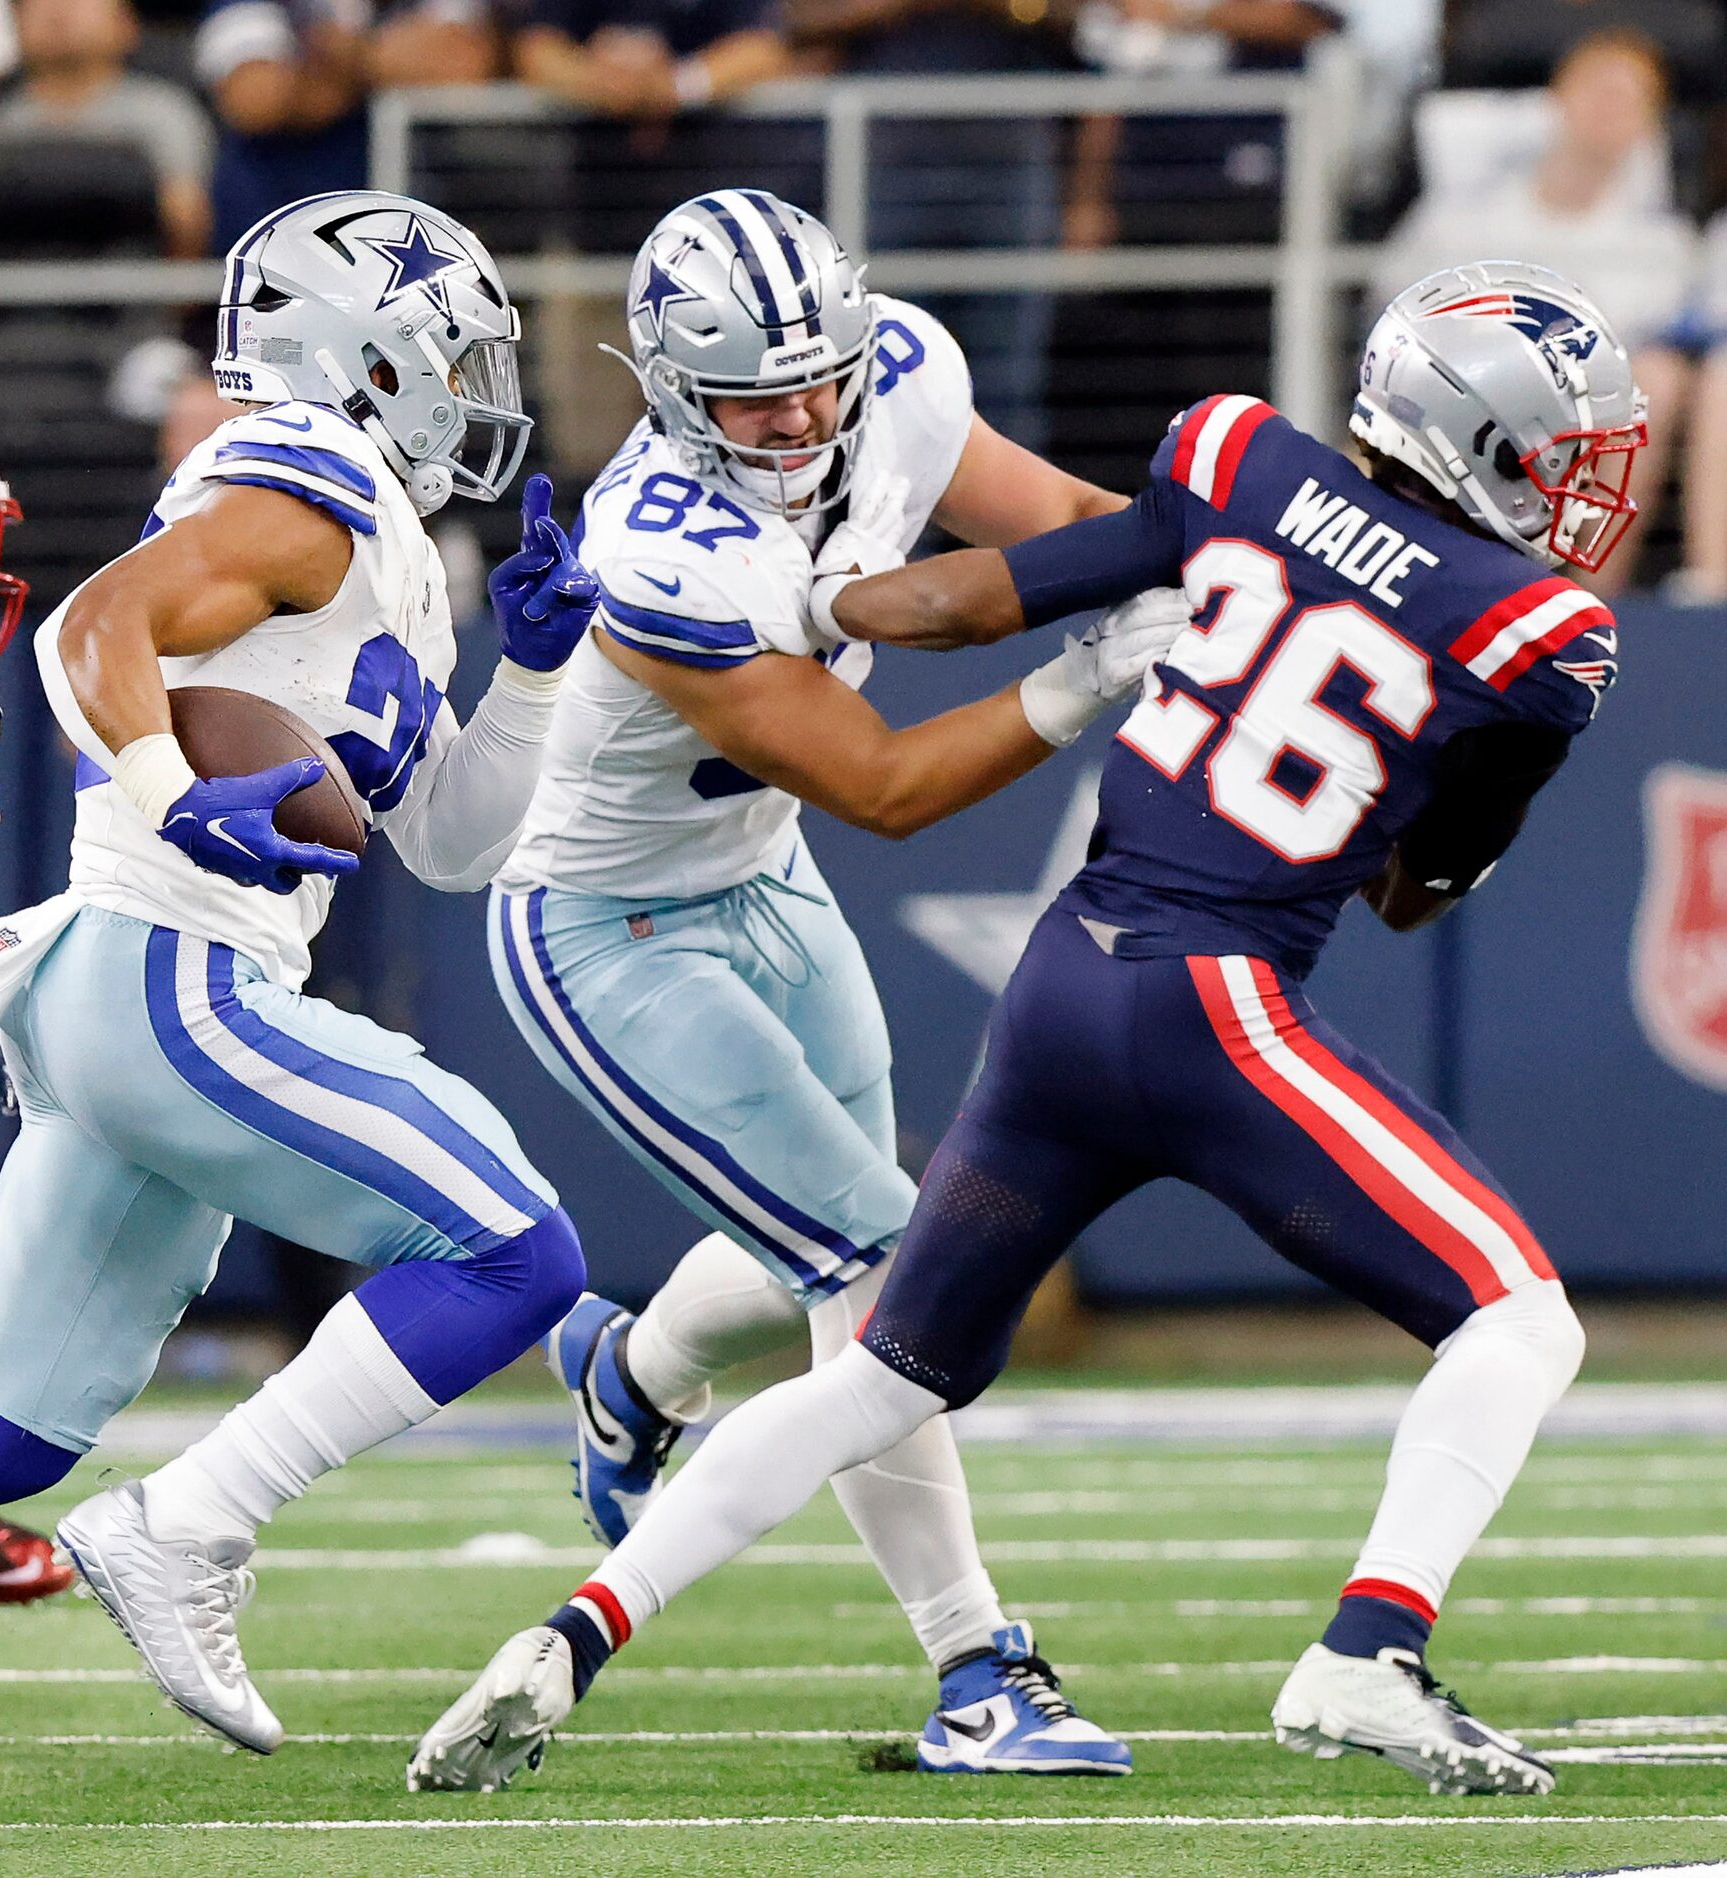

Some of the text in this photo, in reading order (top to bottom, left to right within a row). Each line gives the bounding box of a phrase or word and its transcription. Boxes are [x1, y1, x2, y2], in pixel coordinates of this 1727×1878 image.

[626, 472, 761, 552] 87
[1275, 477, 1441, 608] WADE
[1115, 536, 1438, 865] 26
